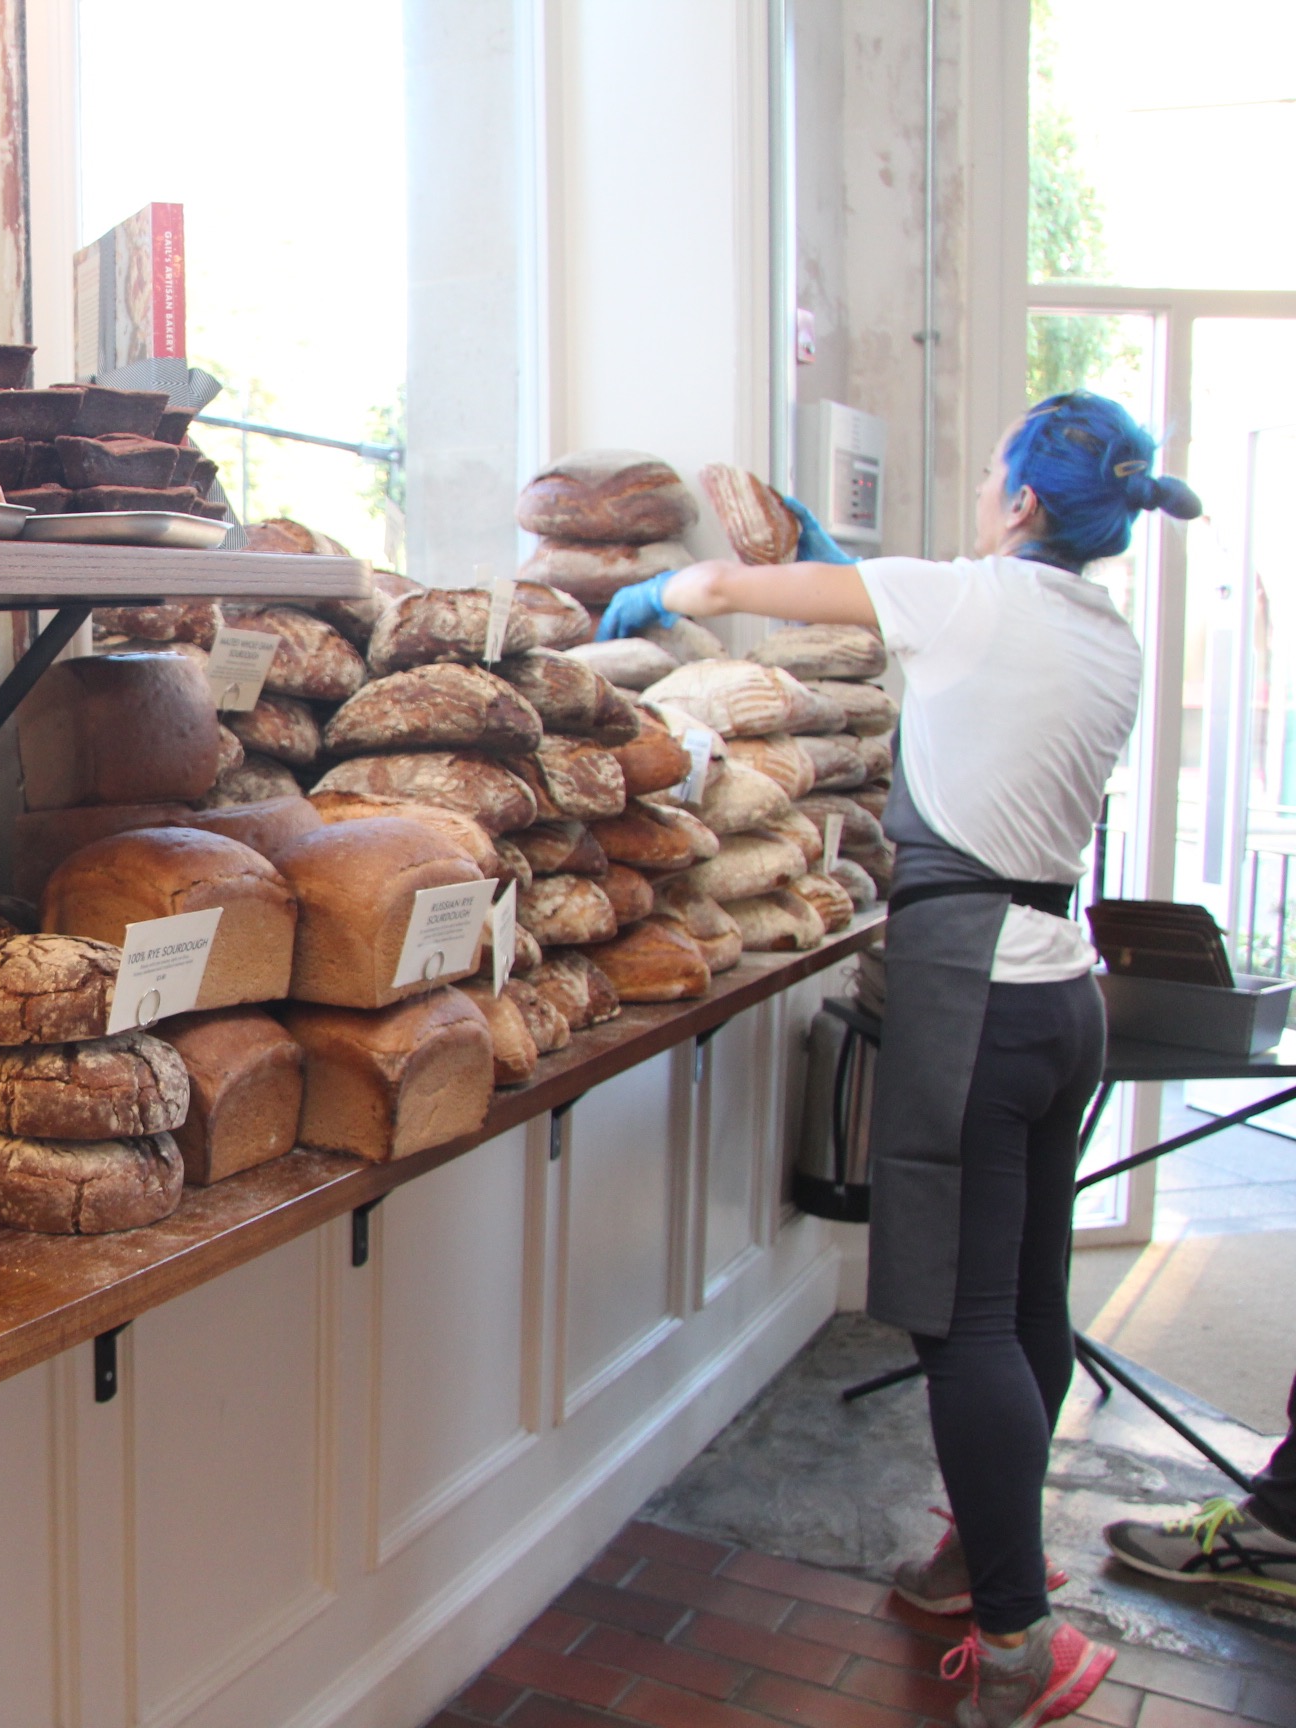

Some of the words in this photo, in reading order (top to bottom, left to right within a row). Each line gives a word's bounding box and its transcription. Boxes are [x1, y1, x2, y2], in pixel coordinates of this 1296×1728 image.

[165, 266, 174, 310] ARTISAN
[166, 314, 174, 353] BAKERY
[127, 951, 146, 965] 100%
[147, 947, 161, 960] RYE
[162, 938, 209, 957] SOURDOUGH
